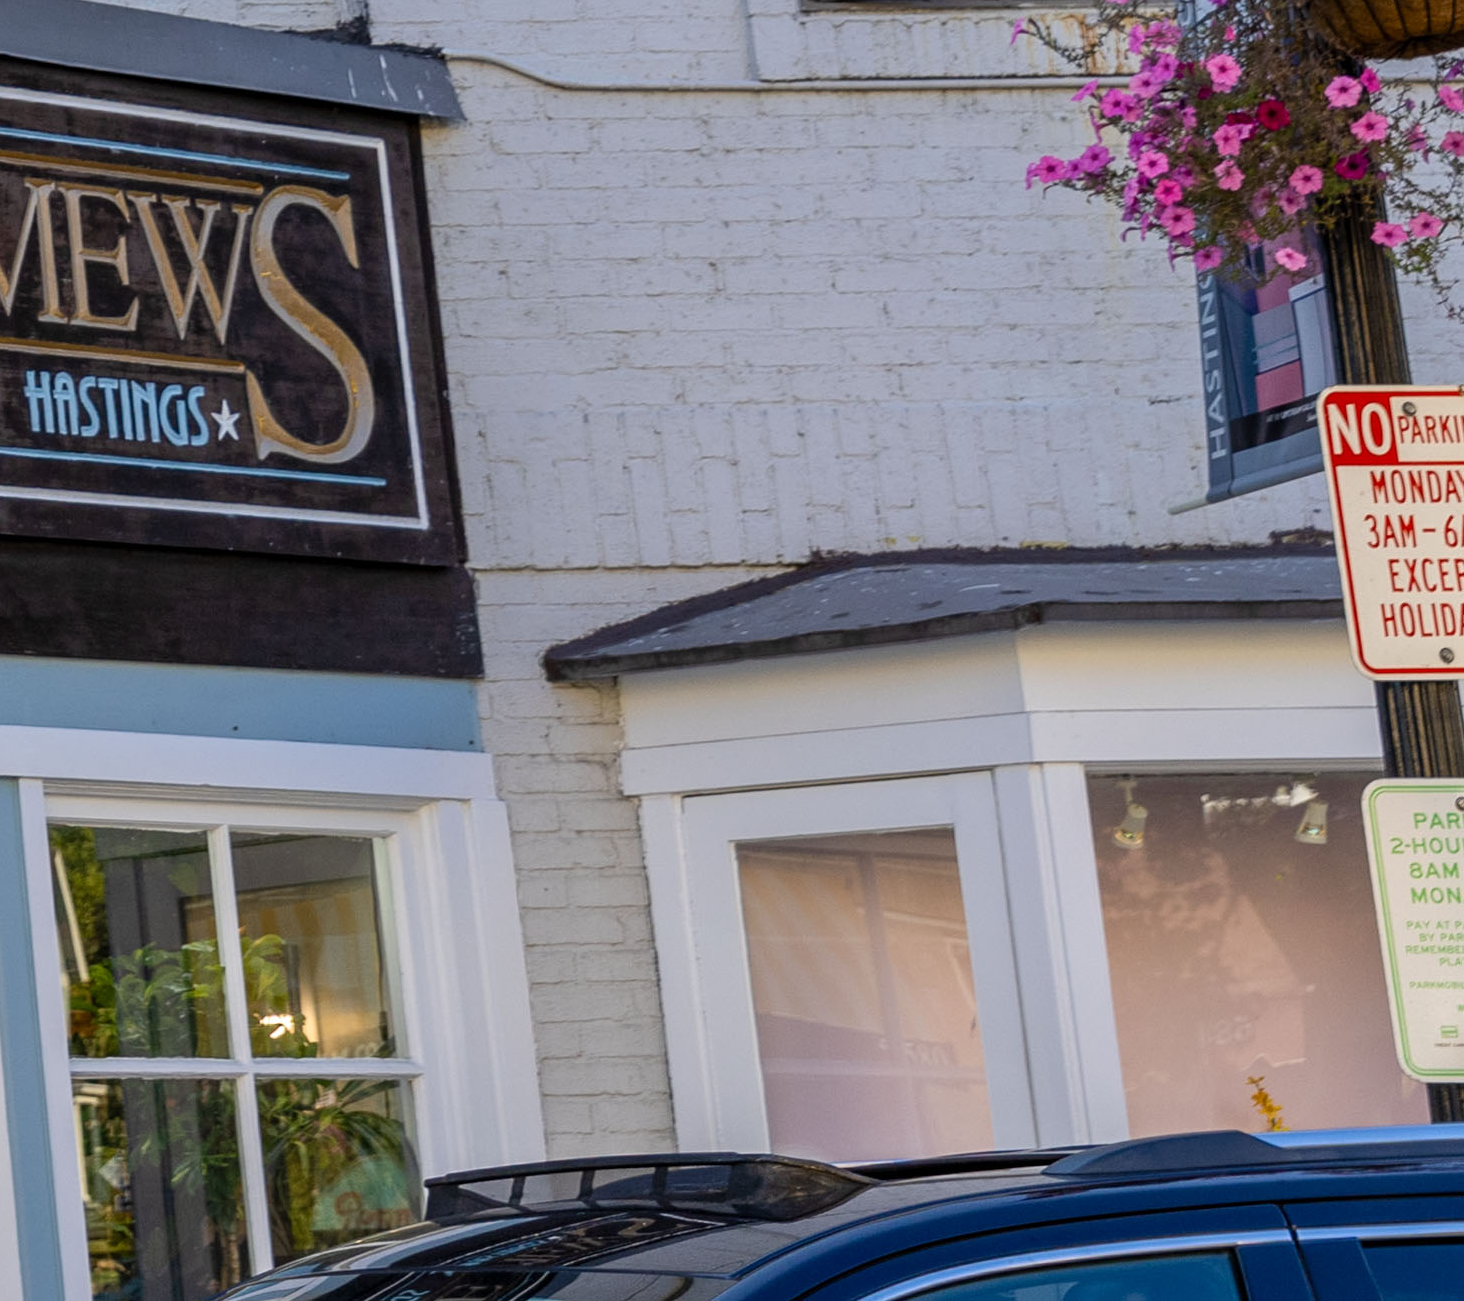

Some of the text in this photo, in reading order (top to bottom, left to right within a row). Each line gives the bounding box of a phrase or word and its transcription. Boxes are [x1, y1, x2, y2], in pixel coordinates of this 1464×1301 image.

[25, 369, 210, 447] HASTINGS
[1326, 402, 1393, 456] NO
[1397, 414, 1464, 444] PARKI
[1363, 514, 1417, 548] 3AM
[1380, 602, 1464, 637] HOLID
[1413, 812, 1464, 830] PAR
[1390, 837, 1464, 854] 2-HOU
[1410, 862, 1459, 879] 8AM
